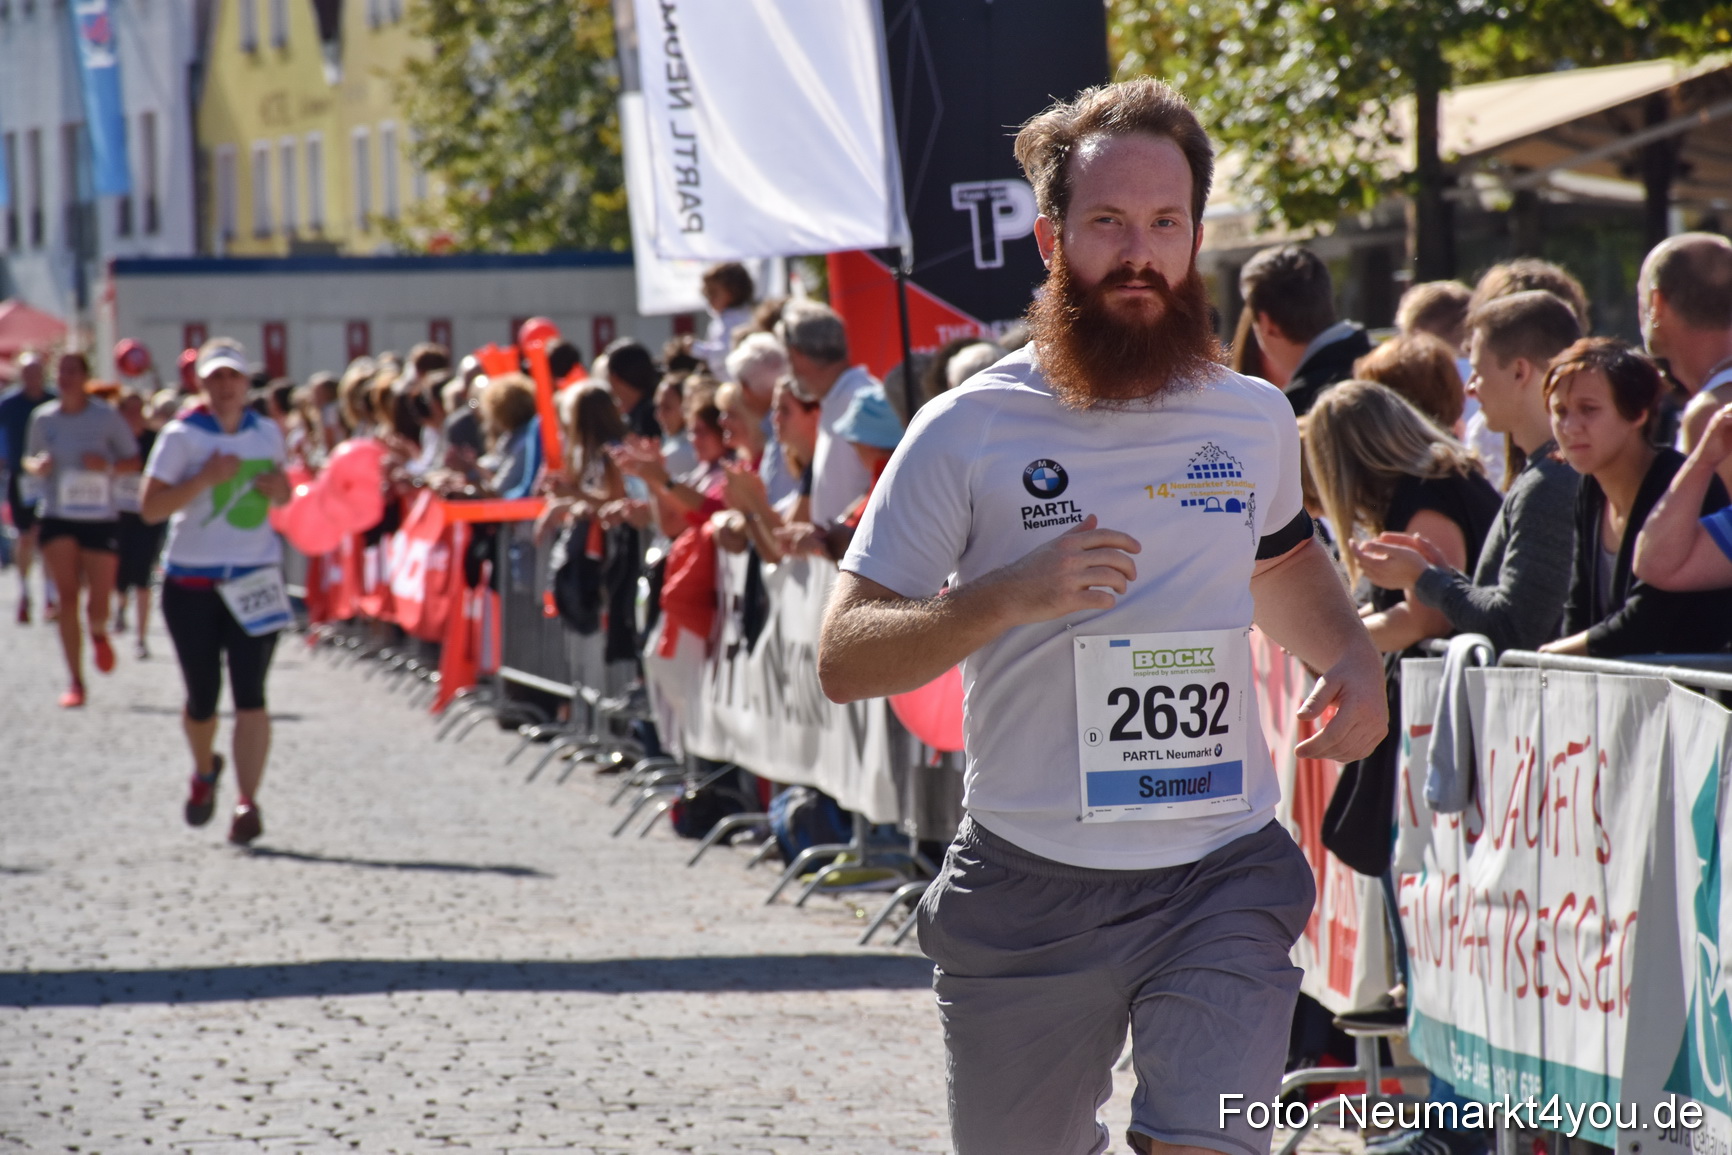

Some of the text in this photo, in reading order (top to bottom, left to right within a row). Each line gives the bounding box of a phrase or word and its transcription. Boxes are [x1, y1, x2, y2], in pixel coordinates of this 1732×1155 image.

[1025, 460, 1062, 475] BMW
[1144, 483, 1175, 499] 14.
[1170, 480, 1224, 490] Neumarkter
[1021, 499, 1082, 520] PARTL
[1023, 513, 1084, 530] Neumarkt
[1133, 648, 1215, 669] BOCK
[1133, 669, 1160, 677] inspired
[1190, 667, 1216, 675] concepts
[1107, 682, 1230, 741] 2632
[1089, 732, 1097, 743] D
[1123, 747, 1212, 761] PARTL Neumarkt
[1139, 771, 1212, 798] Samuel
